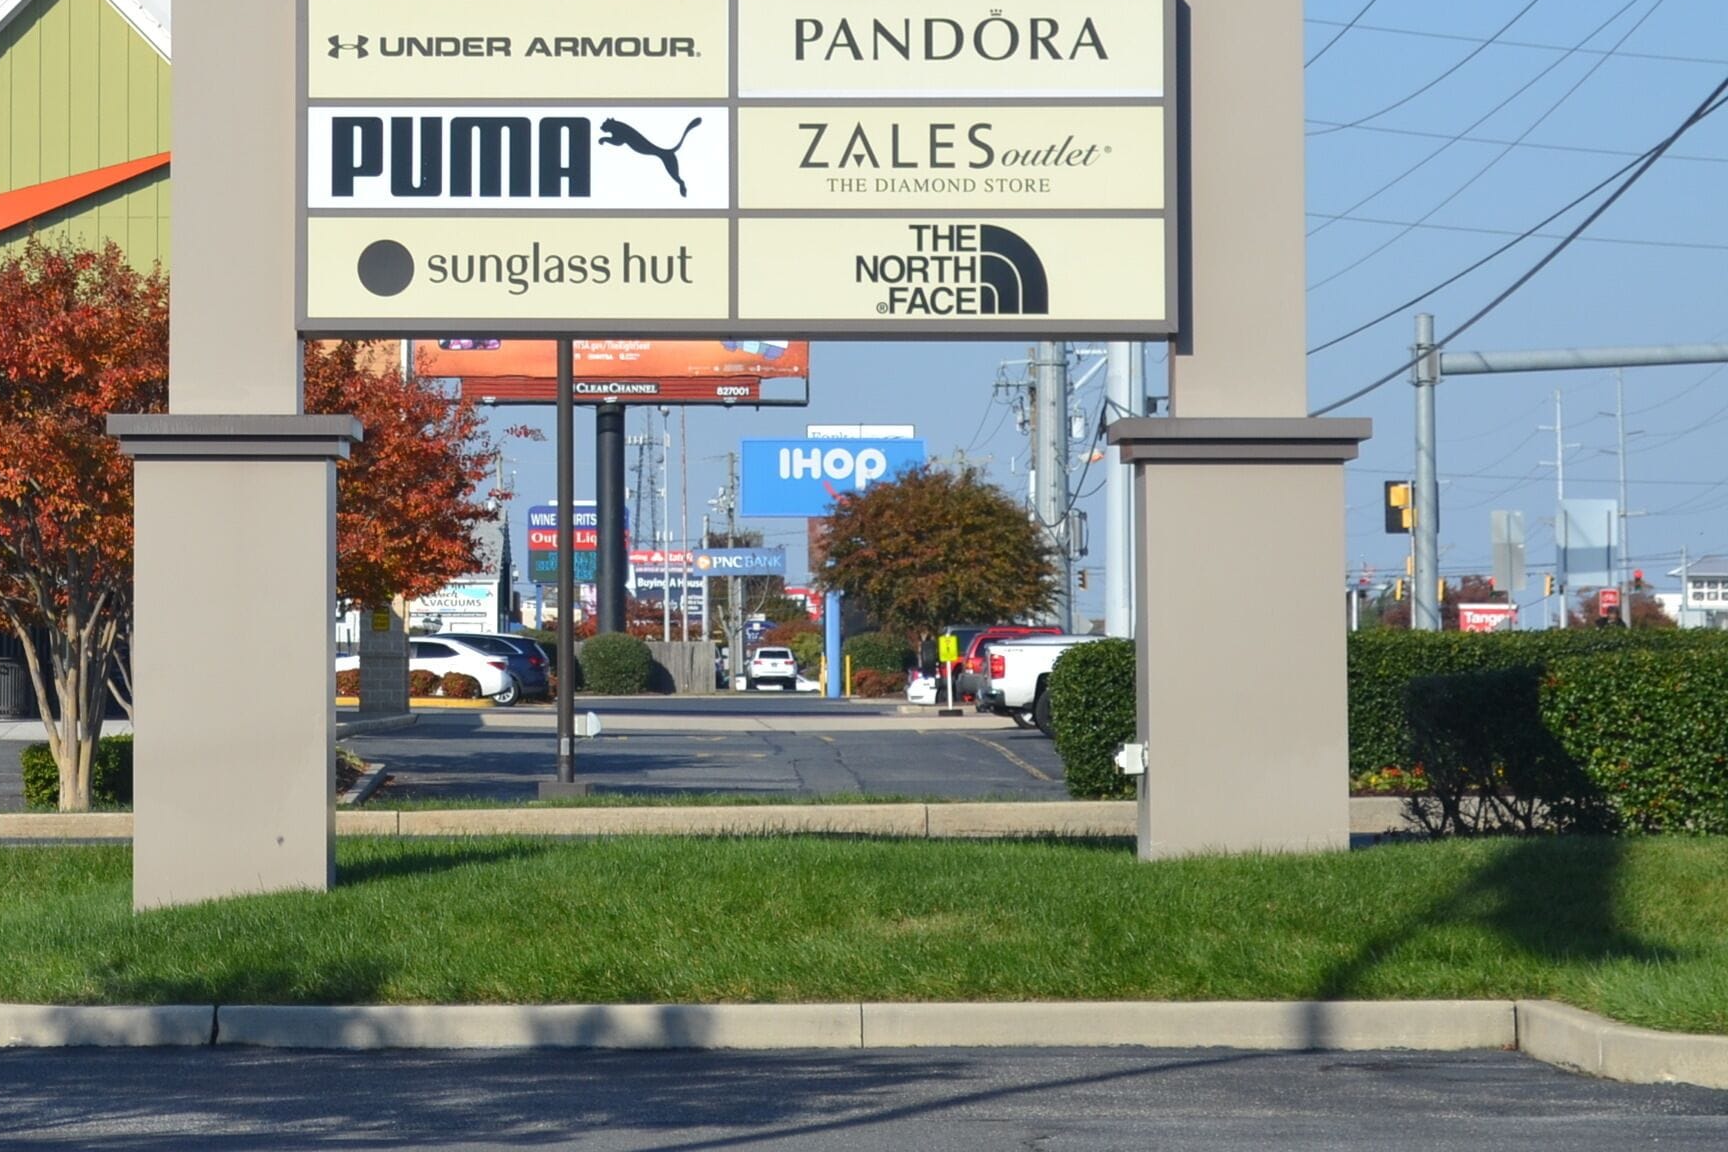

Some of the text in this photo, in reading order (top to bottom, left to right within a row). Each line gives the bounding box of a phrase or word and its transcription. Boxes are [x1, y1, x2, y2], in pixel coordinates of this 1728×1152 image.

[379, 36, 511, 58] UNDER
[794, 15, 1109, 61] PANDORA
[798, 121, 995, 169] ZALES
[331, 116, 591, 197] PUMA
[826, 178, 1051, 193] THE DIAMOND STORE
[908, 224, 977, 252] THE
[427, 241, 693, 295] sunglass hut
[855, 255, 977, 284] NORTH
[716, 386, 750, 396] 827001
[530, 513, 557, 526] WINE
[712, 555, 782, 568] PNC BANK
[669, 578, 676, 587] A
[429, 599, 481, 607] VACUUMS
